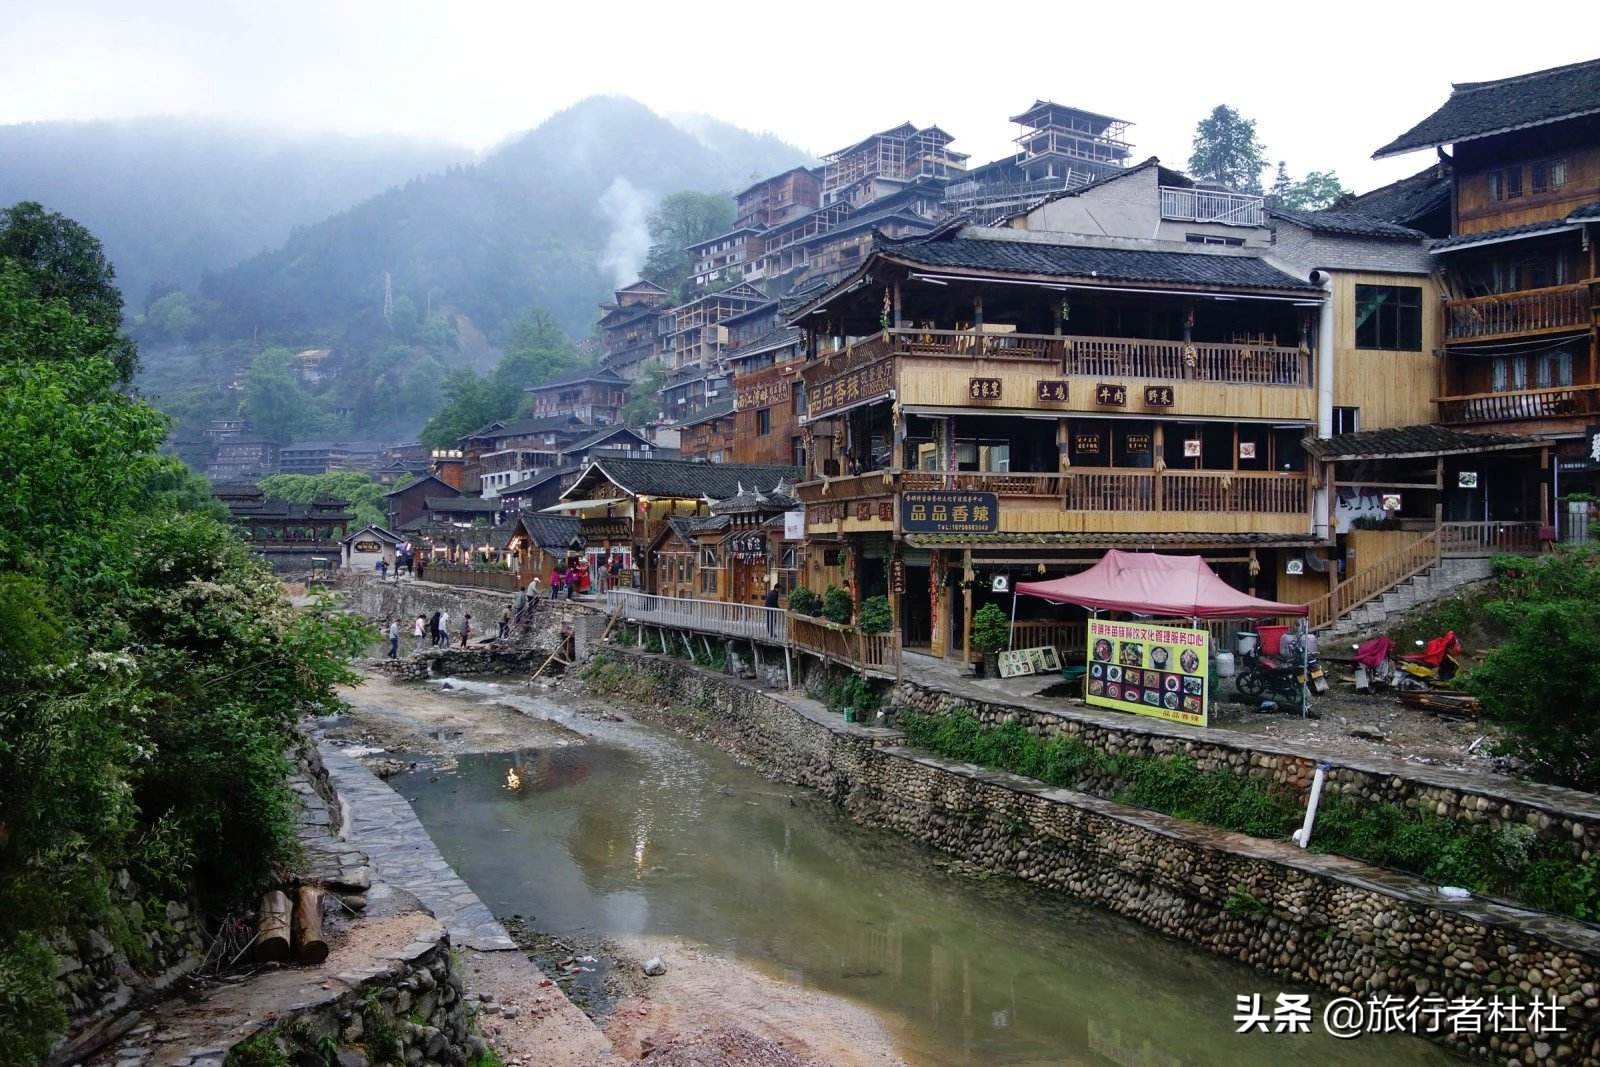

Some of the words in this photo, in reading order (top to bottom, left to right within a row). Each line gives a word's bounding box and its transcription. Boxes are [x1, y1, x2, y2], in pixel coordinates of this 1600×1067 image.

[811, 375, 859, 412] 品品香辣
[1040, 384, 1065, 400] 土鸡
[1099, 387, 1124, 404] 牛肉
[1148, 389, 1171, 404] 野菜
[910, 504, 989, 522] 品品香辣
